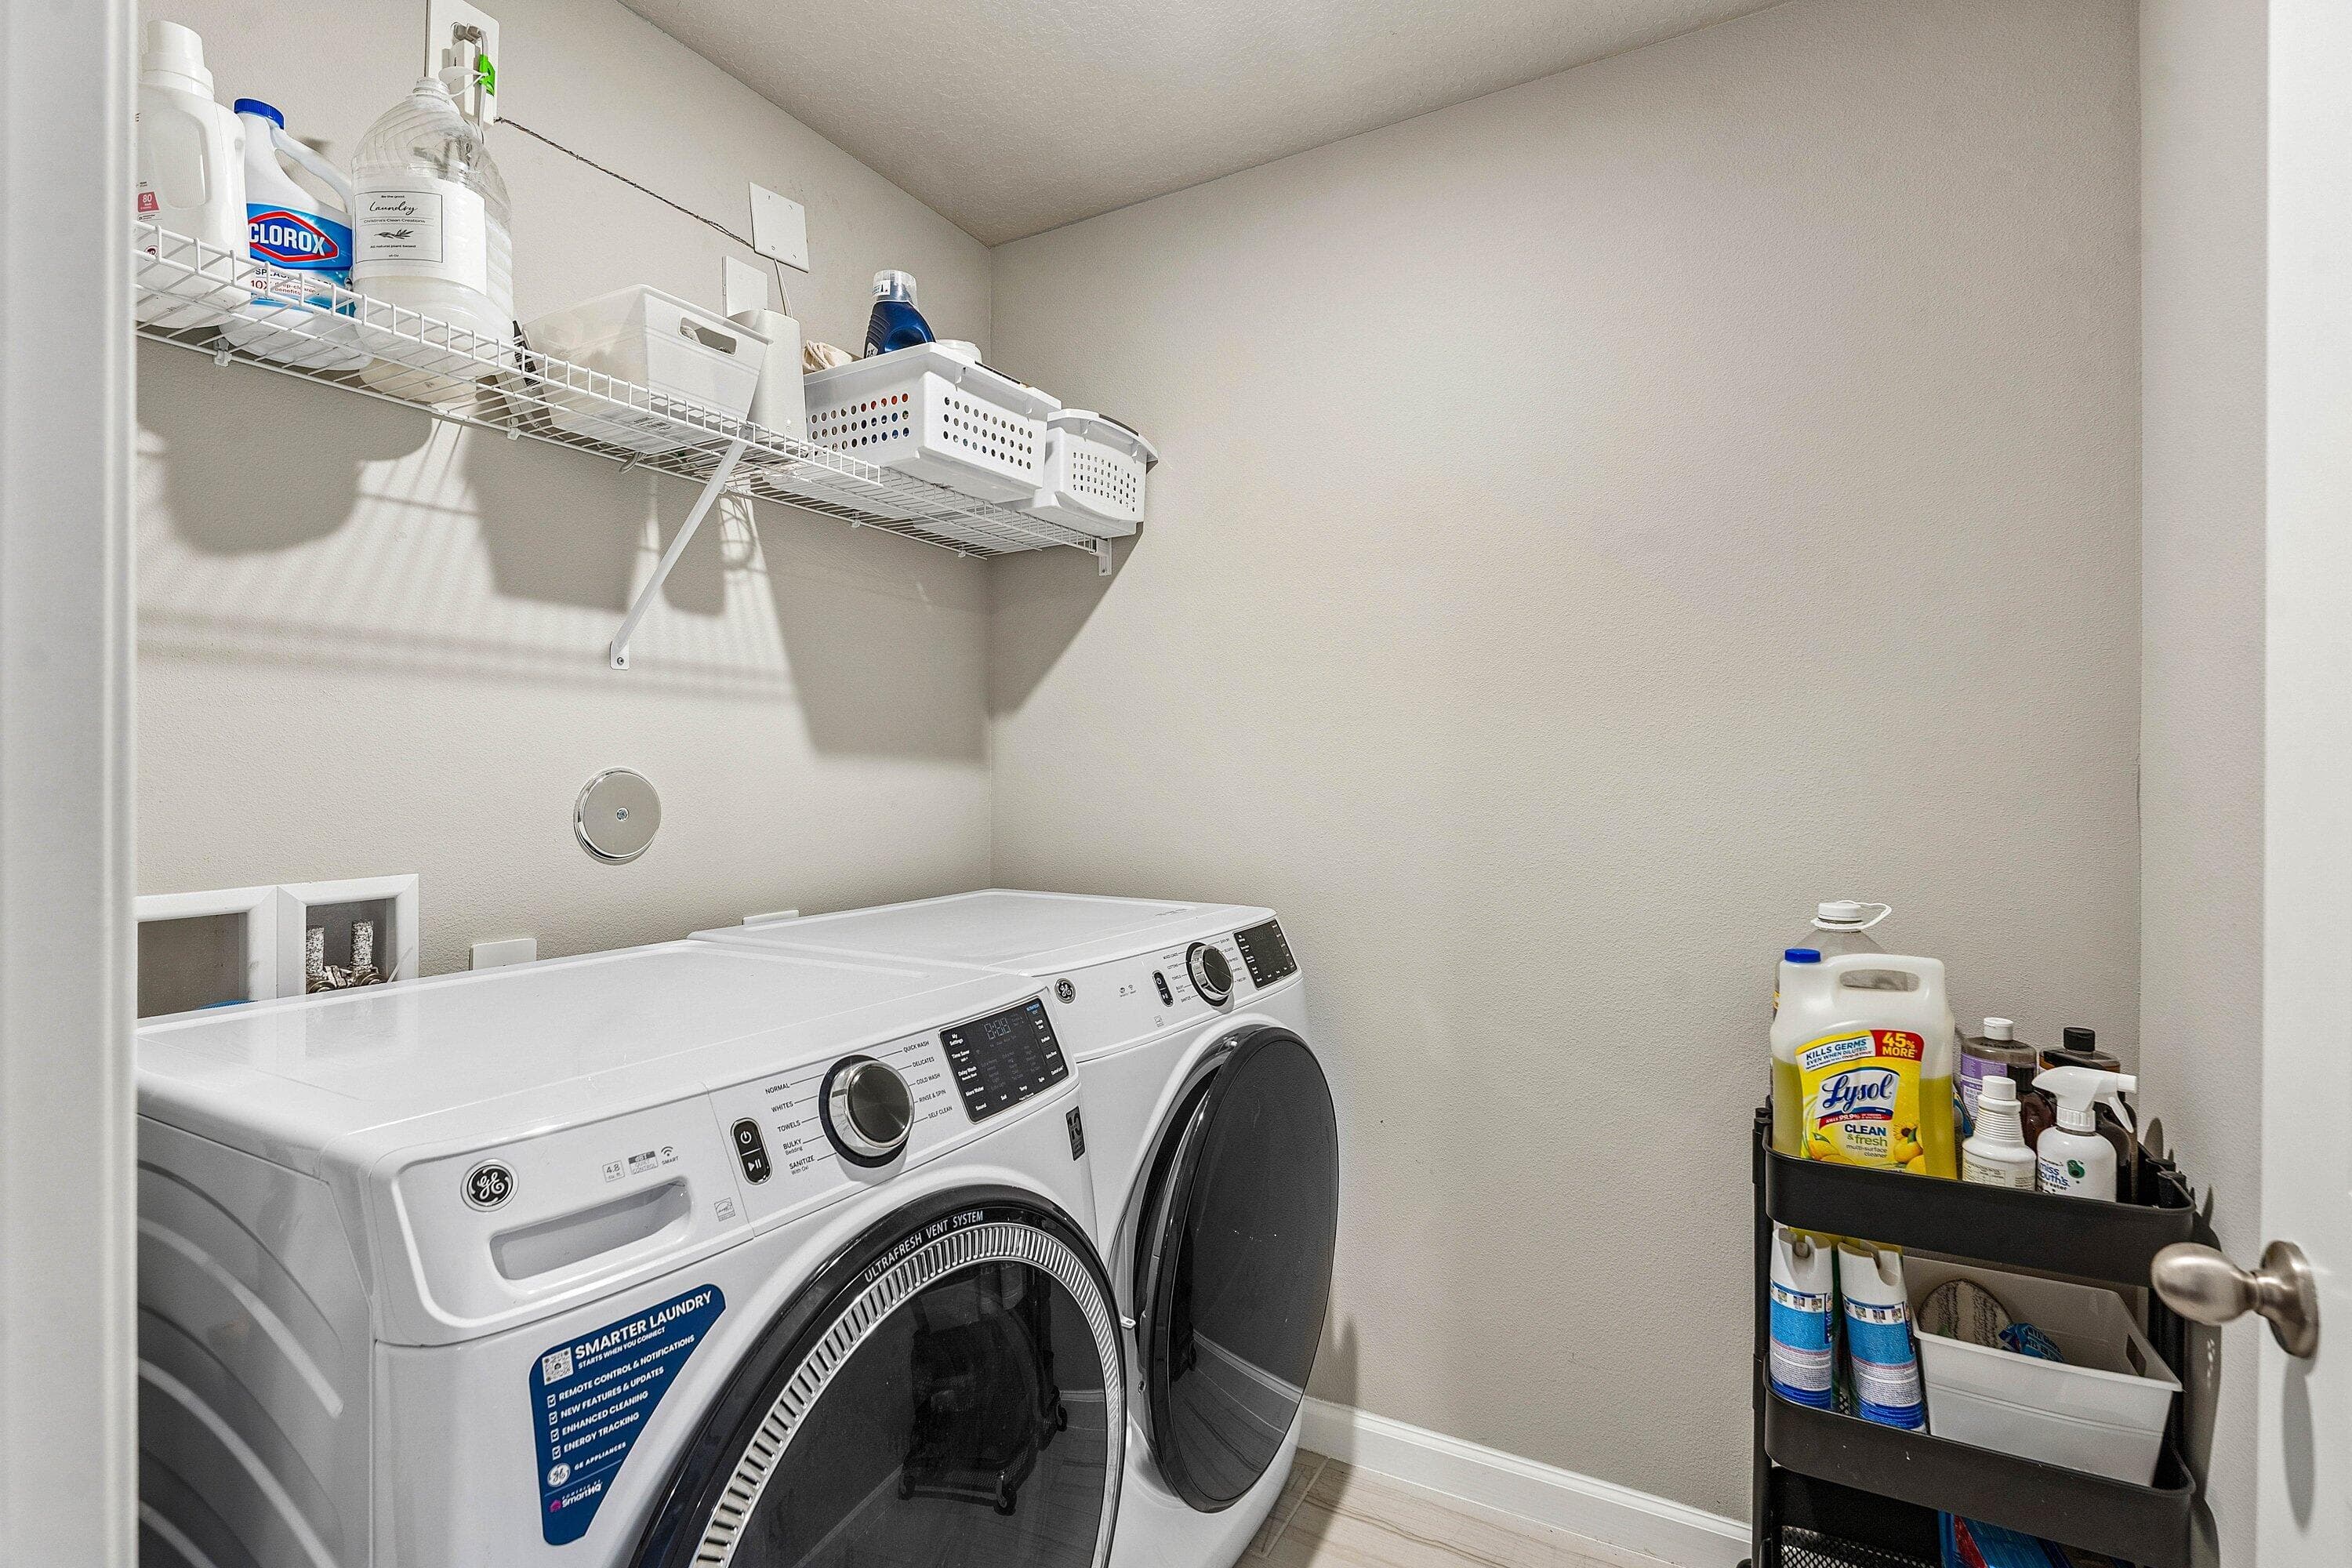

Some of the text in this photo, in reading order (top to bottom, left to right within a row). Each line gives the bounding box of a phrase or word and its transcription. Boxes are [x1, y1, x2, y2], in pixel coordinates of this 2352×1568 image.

[370, 201, 418, 215] Laundry
[249, 223, 325, 256] CLOROX
[1882, 1032, 1915, 1048] 45%
[903, 1045, 916, 1053] QUICK
[1806, 1039, 1866, 1060] KILLS GERMS
[1882, 1047, 1915, 1058] MORE
[912, 1057, 935, 1067] DELICATES
[1806, 1057, 1822, 1066] EVEN
[1823, 1052, 1841, 1061] WHEN
[1842, 1047, 1867, 1056] DILUTED
[765, 1083, 790, 1094] NORMAL
[1822, 1074, 1893, 1112] Lysol
[919, 1094, 931, 1102] RINSE
[771, 1101, 793, 1112] WHITES
[940, 1106, 952, 1114] CLEAN
[777, 1120, 801, 1132] TOWELS
[1845, 1124, 1886, 1136] CLEAN
[783, 1138, 802, 1149] BULKY
[1855, 1134, 1888, 1146] fresh
[785, 1146, 803, 1155] Bedding
[662, 1156, 679, 1165] SMART
[789, 1155, 815, 1169] SANITIZE
[607, 1164, 620, 1173] 4.8
[864, 1210, 983, 1283] ULTRAFRESH VENT SYSTEM
[575, 1291, 712, 1359] SMARTER LAUNDRY
[578, 1327, 665, 1369] STARTS WHEN YOU CONNECT
[559, 1334, 695, 1401] REMOTE CONTROL & NOTIFICATIONS
[561, 1366, 664, 1419] NEW FEATURES & UPDATES
[562, 1390, 648, 1436] ENHANCED CLEANING
[563, 1412, 639, 1453] ENERGY TRACKING
[585, 1442, 626, 1465] APPLIANCES
